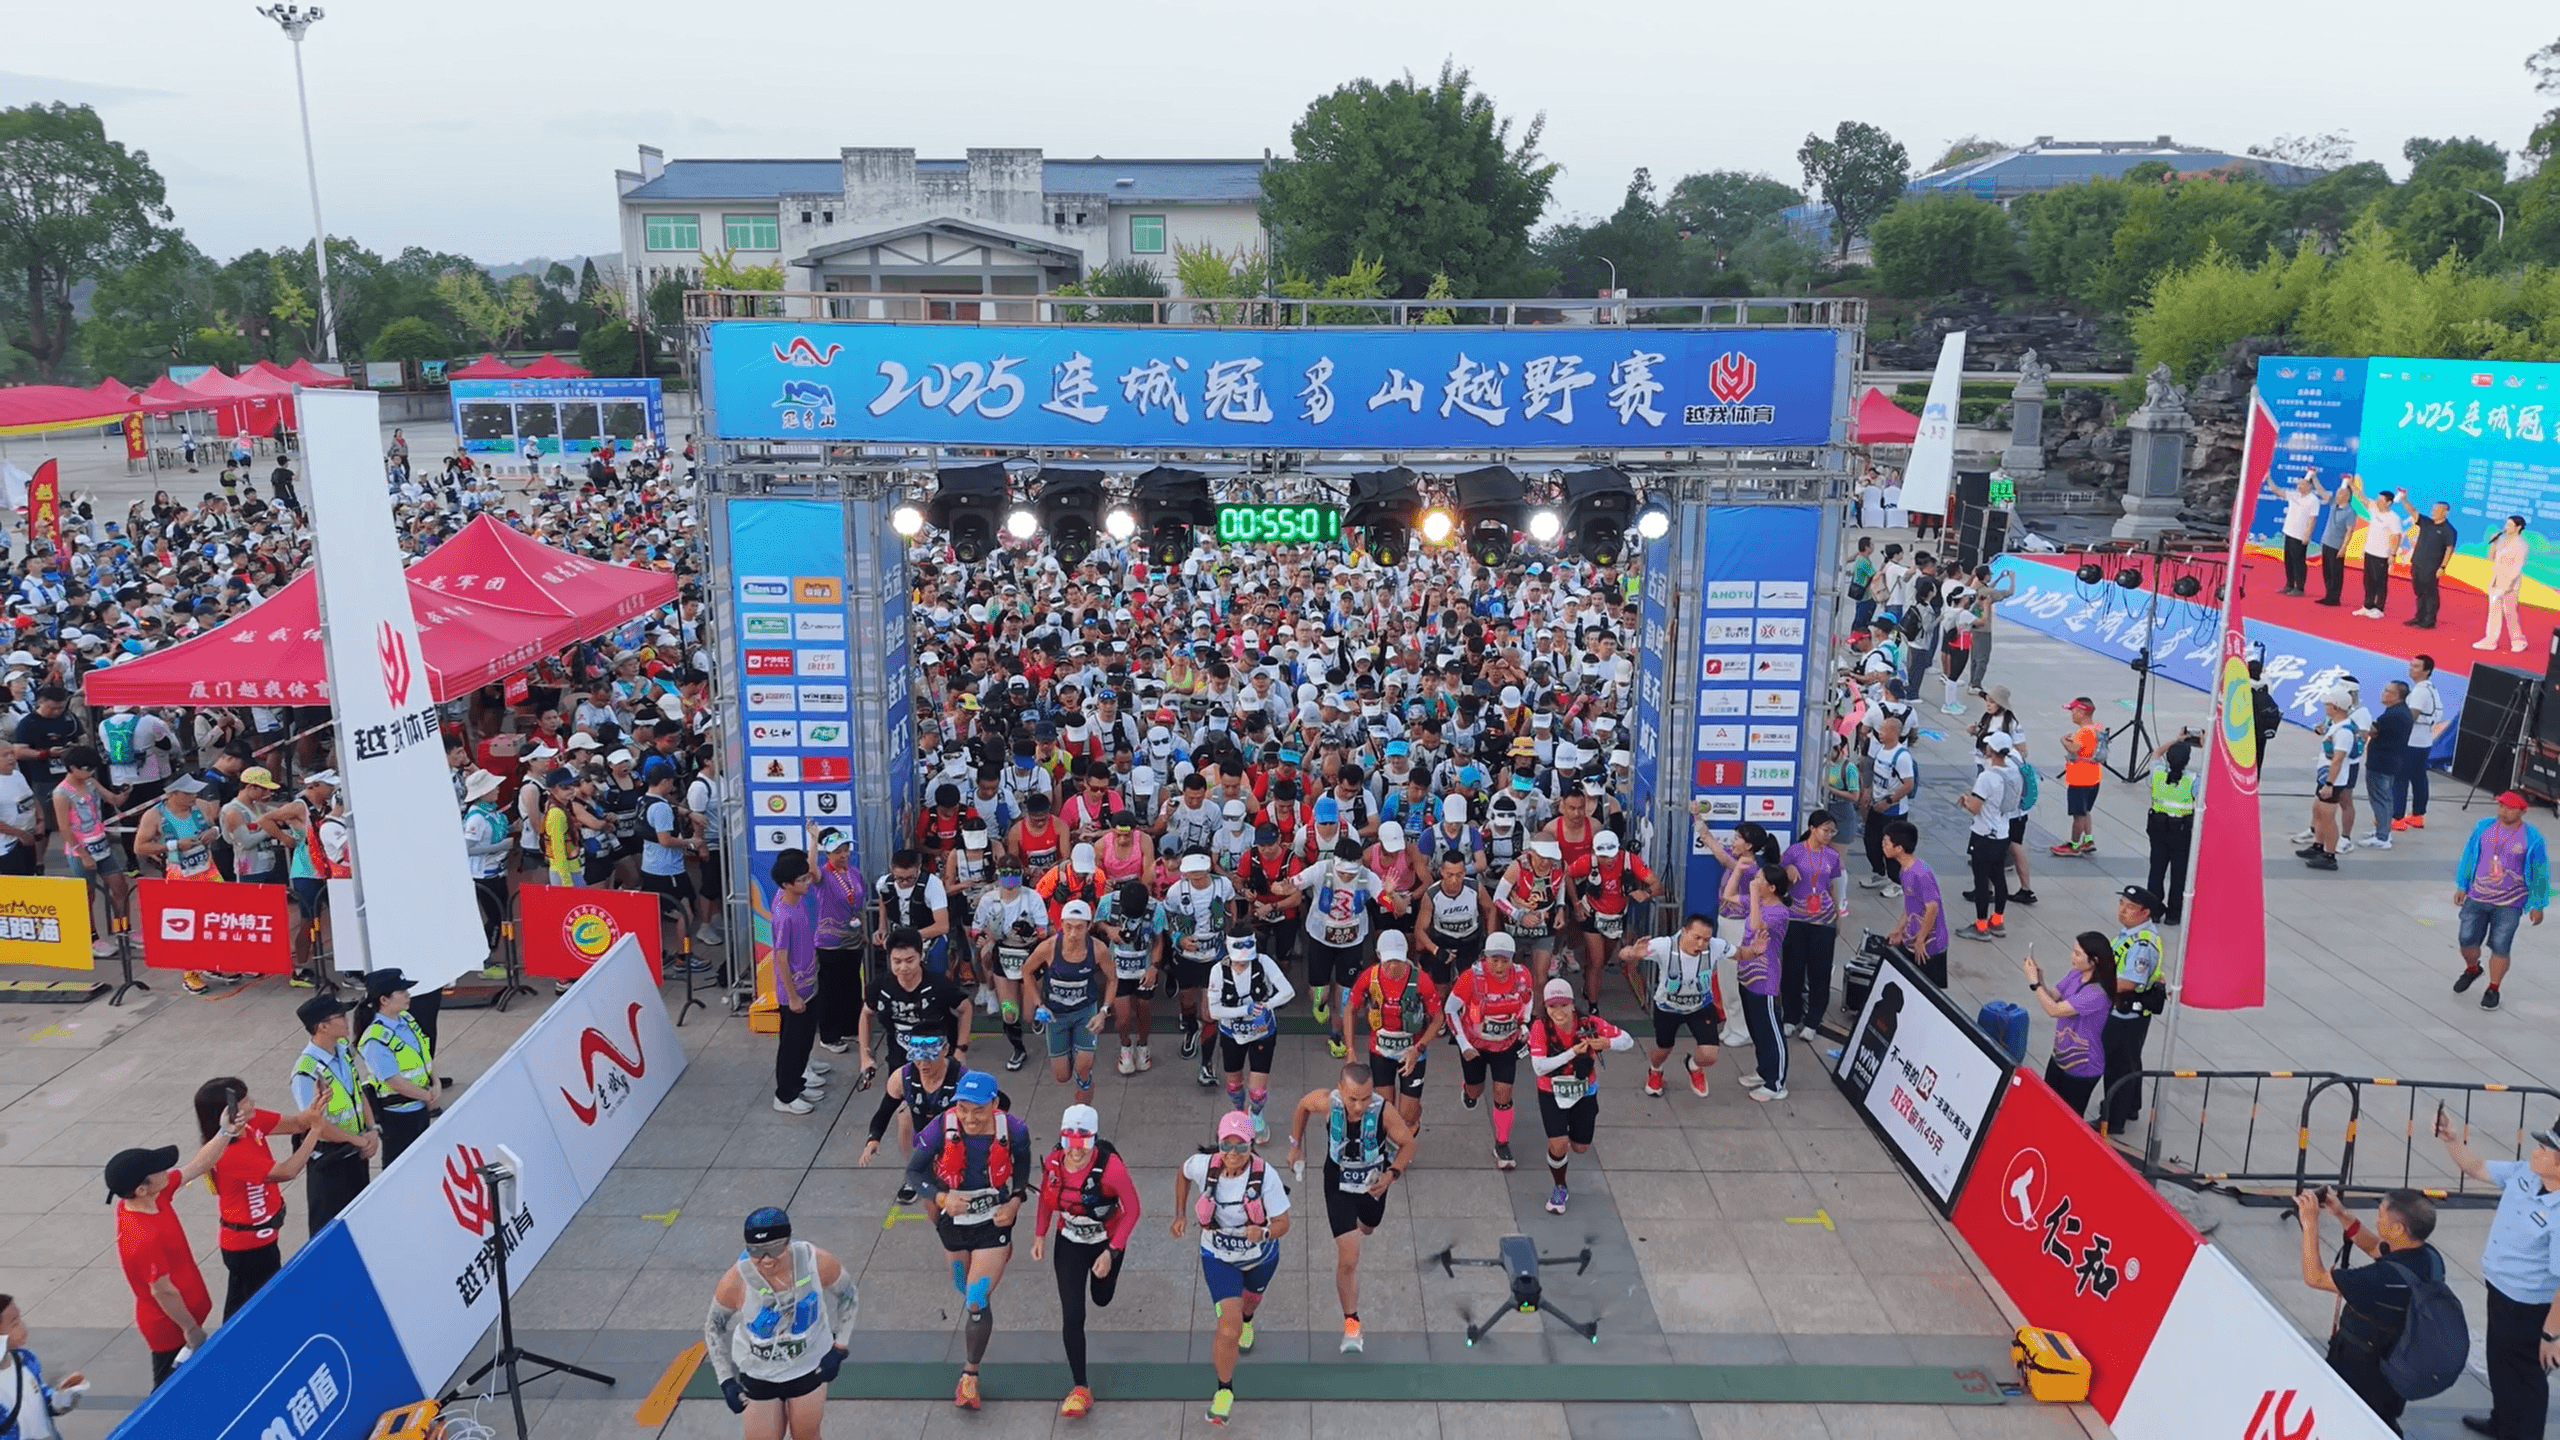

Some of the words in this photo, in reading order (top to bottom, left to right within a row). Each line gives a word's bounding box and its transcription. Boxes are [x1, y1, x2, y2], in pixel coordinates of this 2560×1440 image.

[1683, 404, 1776, 425] 越我体育
[1219, 506, 1338, 542] 00:55:01
[203, 912, 273, 931] 户外特工
[2042, 1196, 2119, 1302] 仁和
